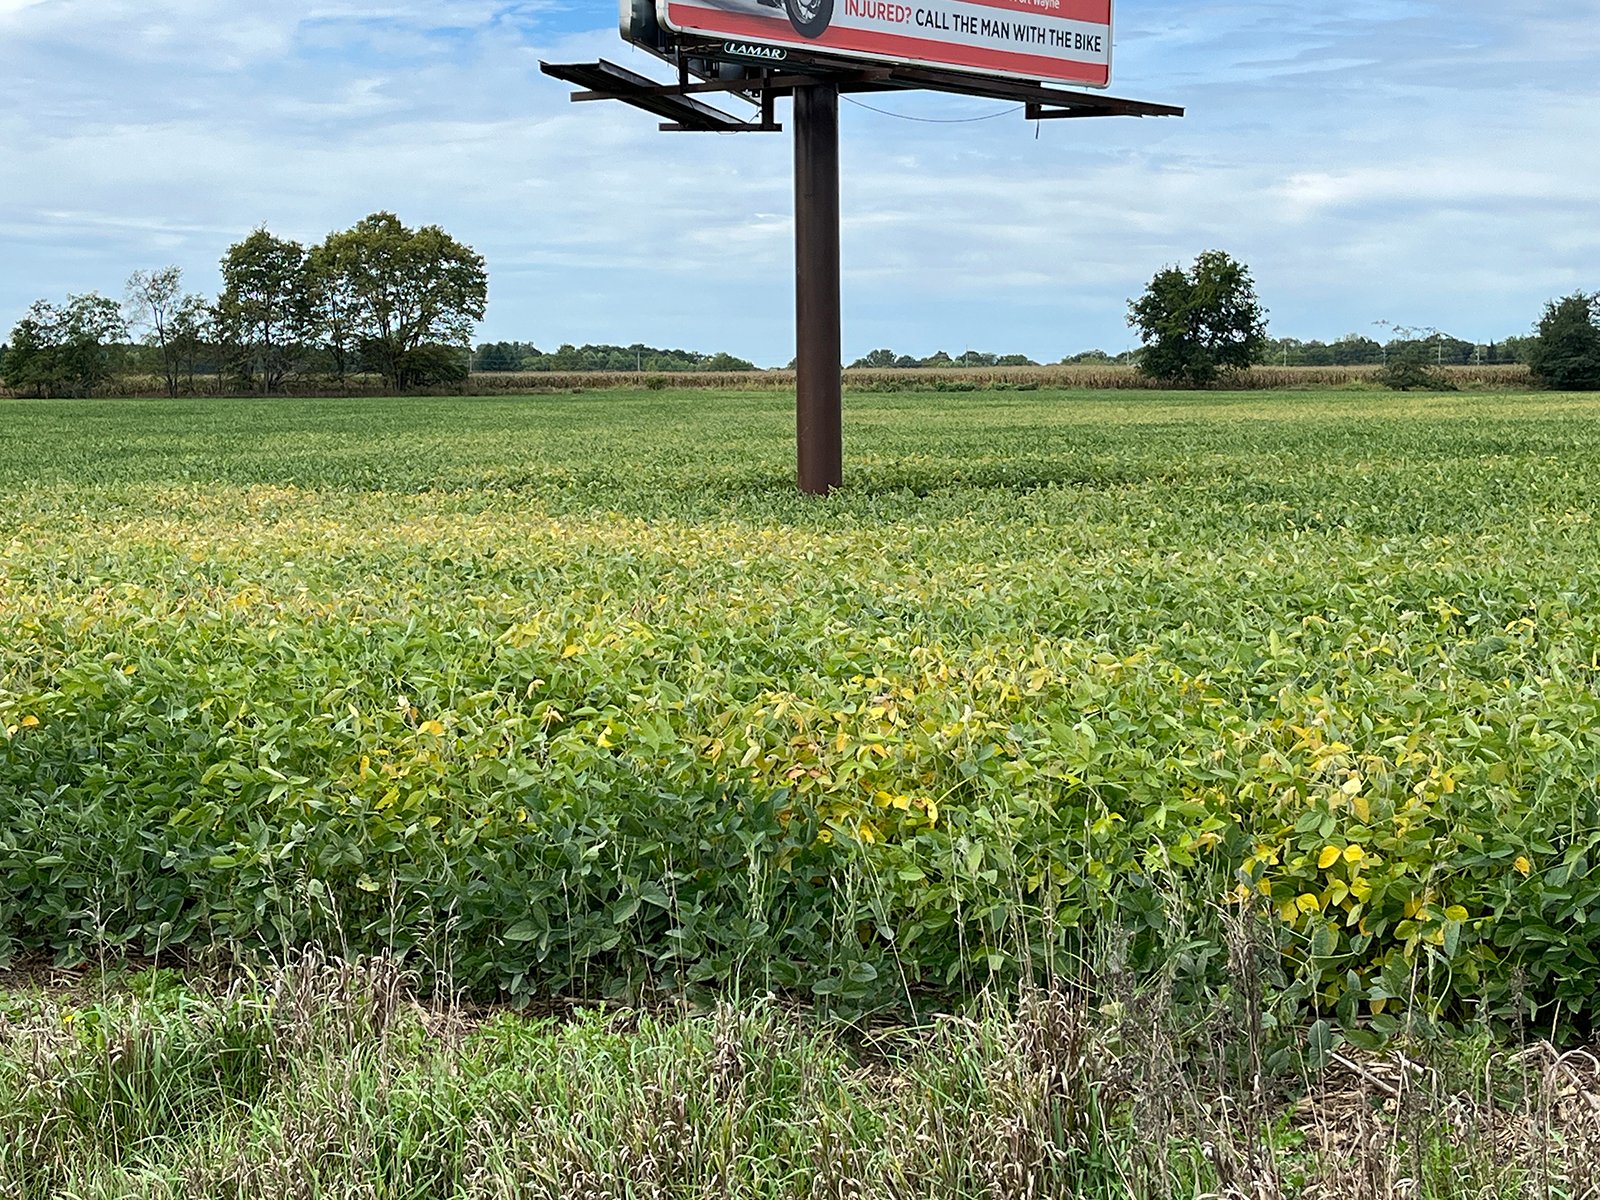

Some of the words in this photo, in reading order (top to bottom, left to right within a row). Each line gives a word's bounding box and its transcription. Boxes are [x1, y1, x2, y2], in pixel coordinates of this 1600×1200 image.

[845, 0, 912, 24] INJURED?
[915, 9, 950, 31] CALL
[953, 14, 978, 35] THE
[981, 19, 1010, 40] MAN
[1012, 24, 1046, 44] WITH
[1048, 29, 1072, 49] THE
[1075, 33, 1101, 53] BIKE
[729, 43, 781, 59] LAMAR
